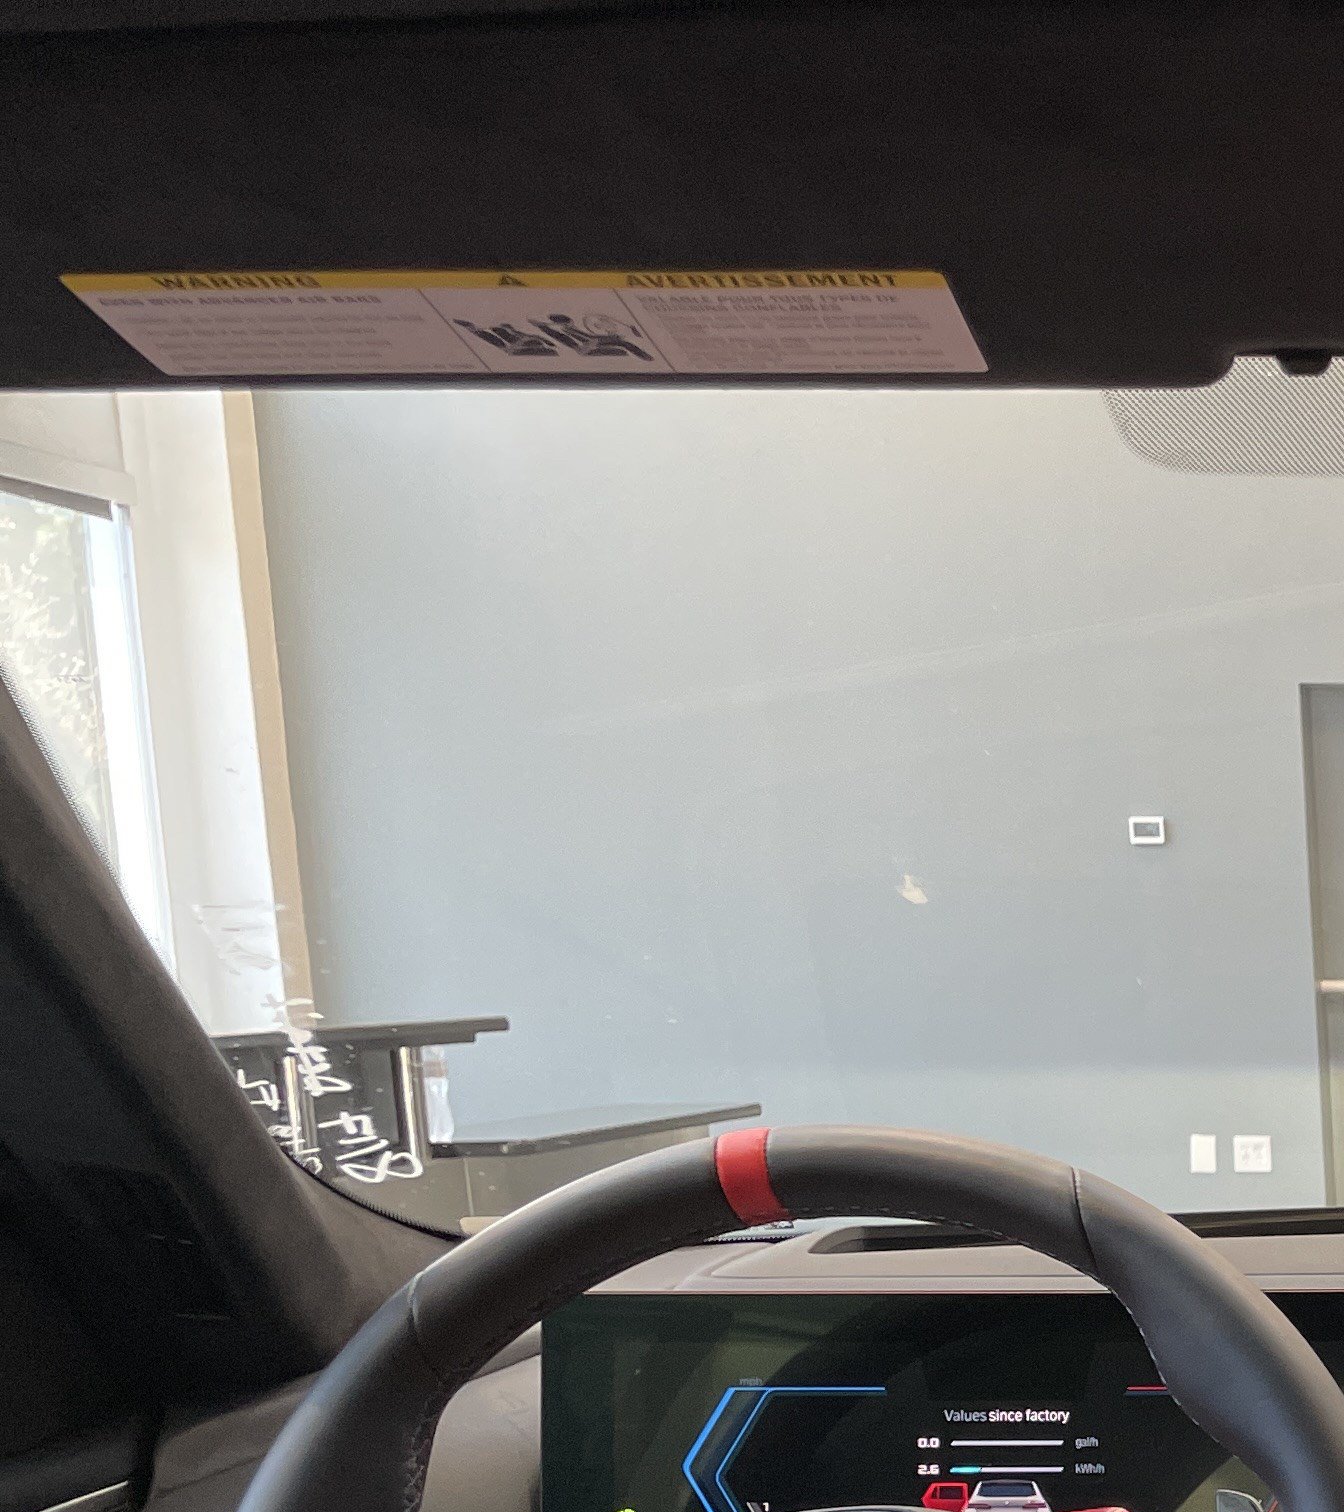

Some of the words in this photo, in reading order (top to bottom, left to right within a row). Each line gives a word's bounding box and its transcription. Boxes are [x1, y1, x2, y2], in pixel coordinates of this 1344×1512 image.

[150, 275, 322, 289] WARNING
[626, 274, 898, 288] AVERTISSEMENT
[943, 1409, 988, 1422] Values
[988, 1409, 1023, 1422] since
[1025, 1408, 1070, 1425] factory
[917, 1437, 941, 1449] 0.0
[917, 1464, 940, 1476] 2.6
